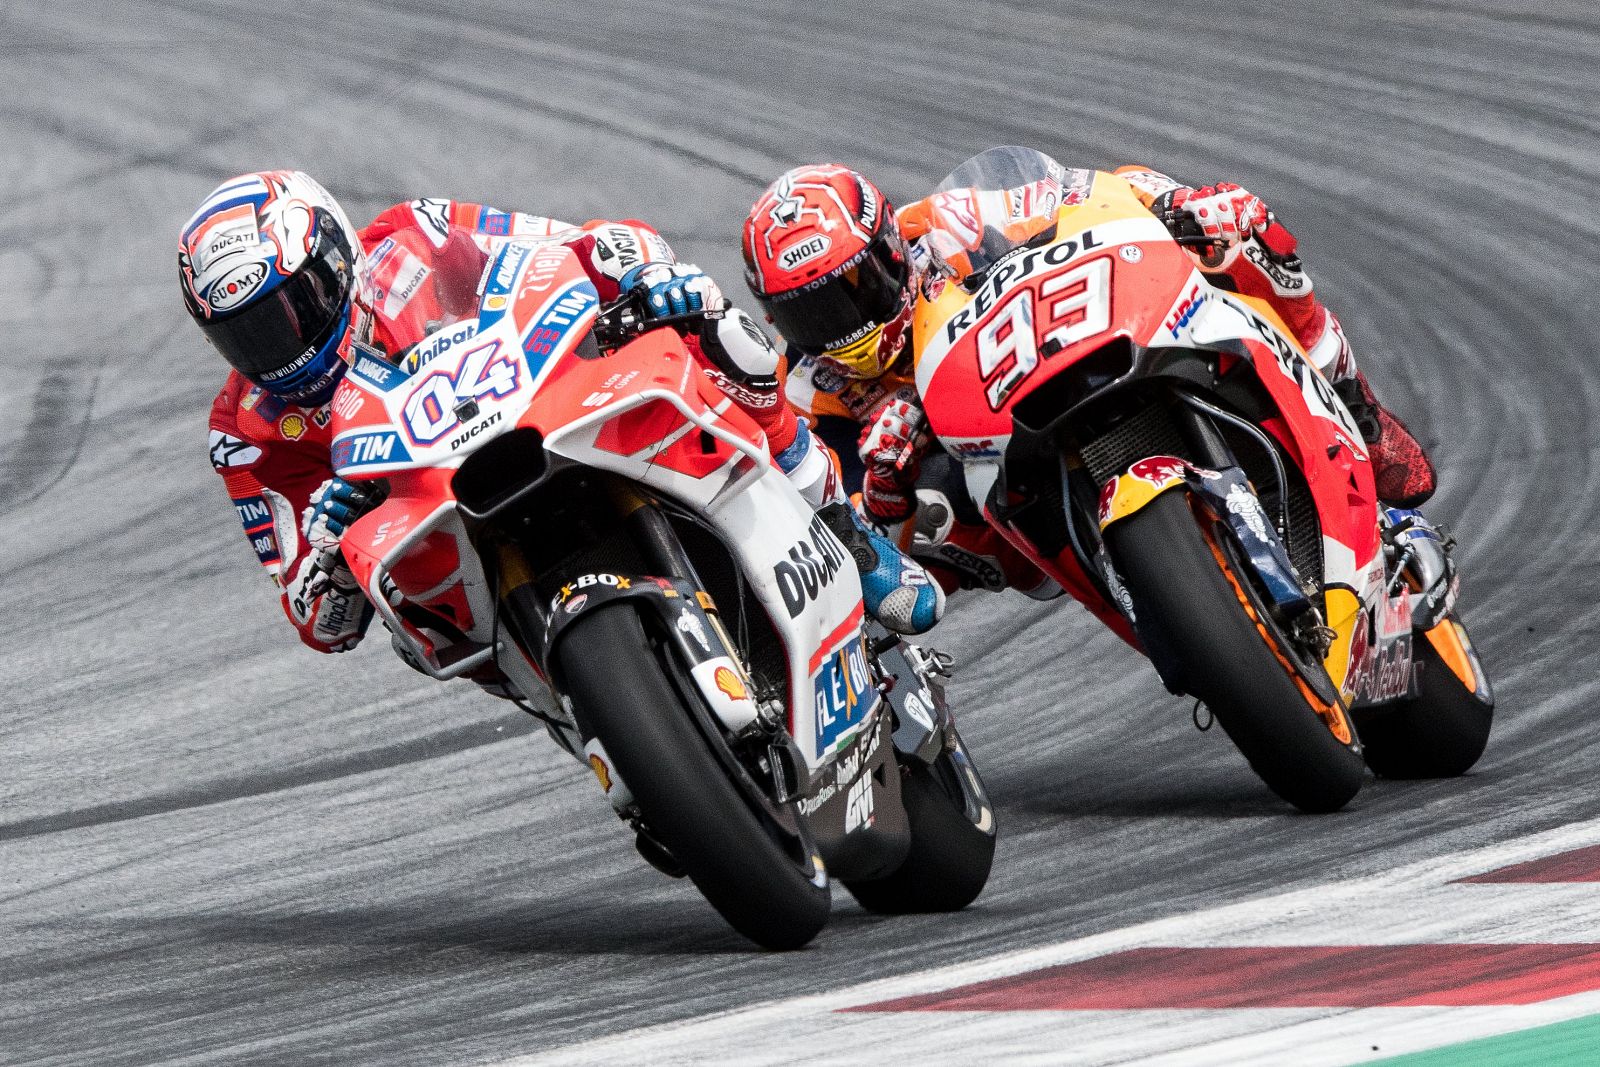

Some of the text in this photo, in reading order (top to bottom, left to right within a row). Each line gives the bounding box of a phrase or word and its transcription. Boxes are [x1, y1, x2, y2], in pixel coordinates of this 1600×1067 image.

[211, 232, 255, 254] DUCATI
[783, 238, 825, 267] SHOEI
[400, 266, 427, 301] DUCATI
[804, 276, 828, 294] YOU
[831, 250, 869, 278] WINGS
[946, 230, 1104, 345] REPSOL
[542, 289, 596, 328] TIM
[1165, 285, 1204, 340] HRC
[405, 325, 476, 375] Unibat
[825, 320, 877, 351] PULL&BEAR
[975, 253, 1115, 412] 93
[275, 362, 298, 378] WILD
[295, 345, 317, 367] WEST
[400, 337, 522, 448] 04
[351, 433, 397, 463] TIM
[451, 411, 503, 452] DUCATI
[236, 500, 269, 522] TIM
[773, 515, 846, 620] DUCATI
